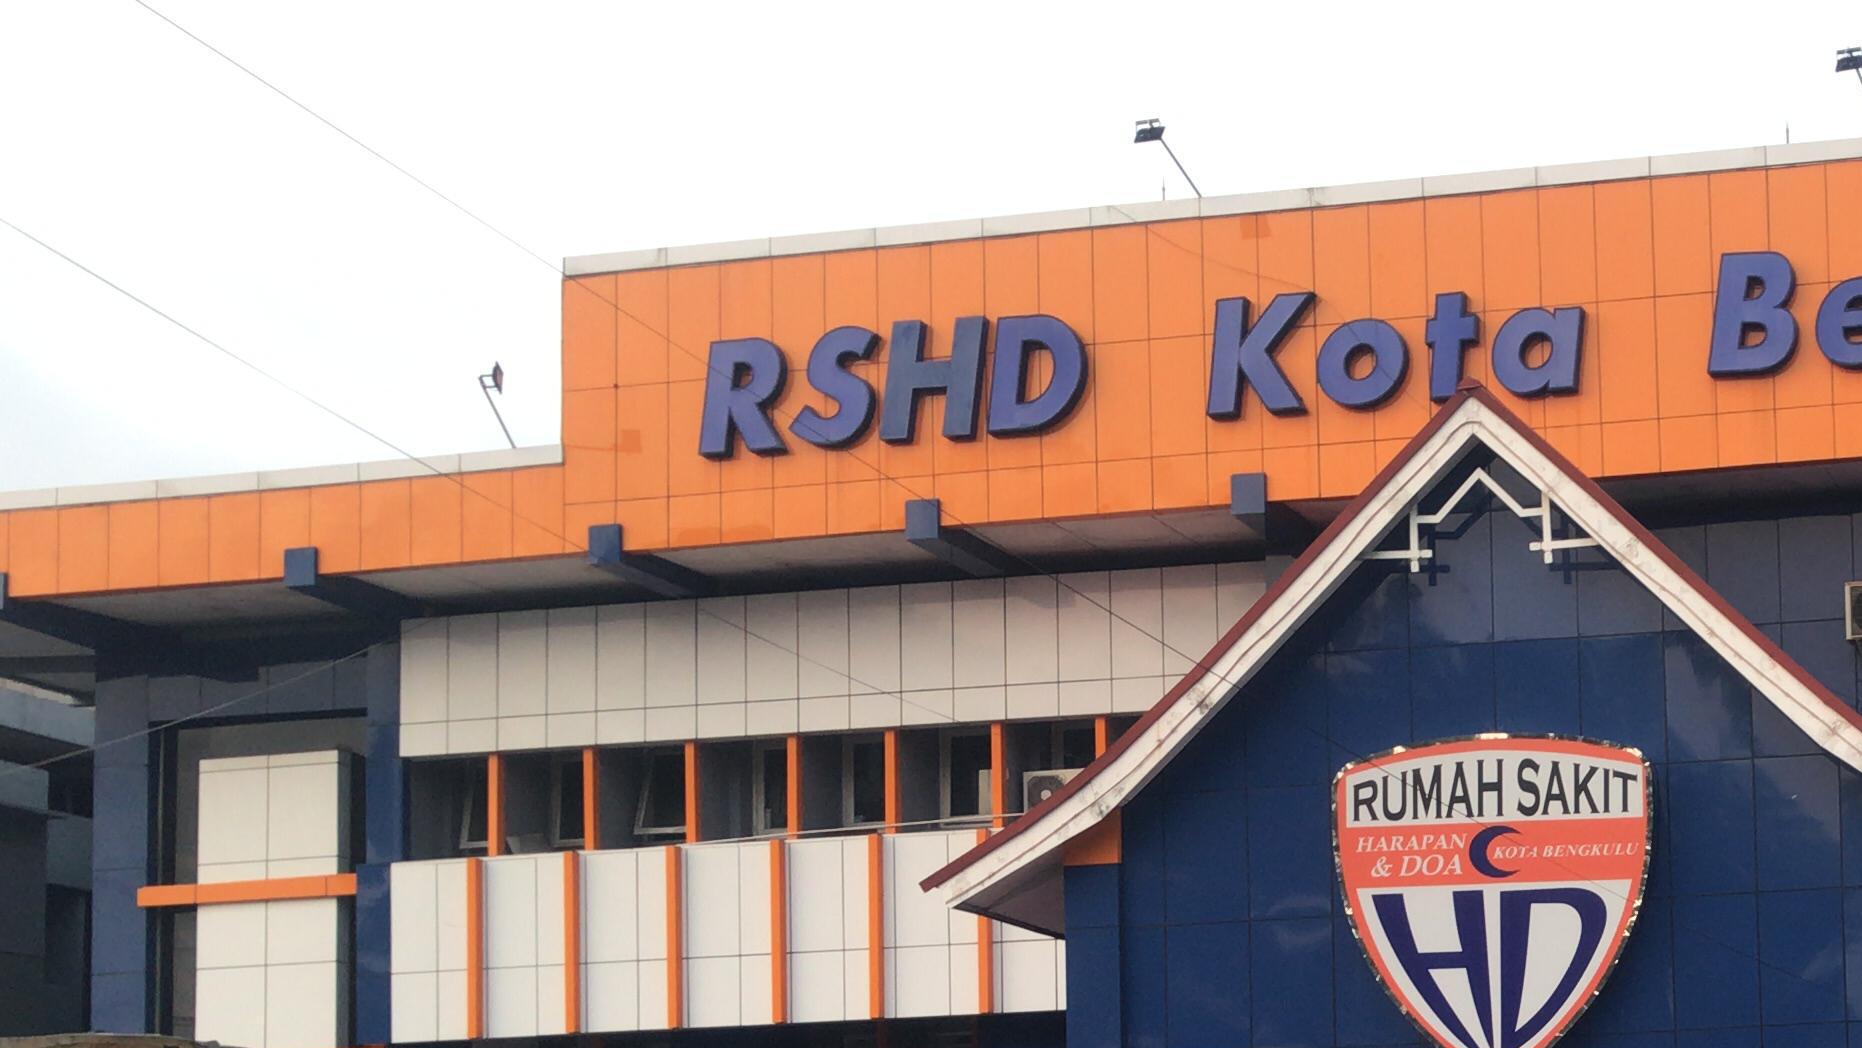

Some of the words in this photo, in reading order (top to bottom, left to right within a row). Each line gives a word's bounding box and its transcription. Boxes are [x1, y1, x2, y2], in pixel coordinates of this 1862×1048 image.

[699, 314, 1088, 459] RSHD
[1206, 291, 1586, 421] Kota
[1352, 757, 1505, 822] RUMAH
[1516, 757, 1638, 817] SAKIT
[1356, 833, 1468, 852] HARAPAN
[1493, 844, 1538, 859] KOTA
[1542, 842, 1639, 858] BENGKULU
[1371, 856, 1392, 877] &
[1399, 854, 1463, 877] DOA
